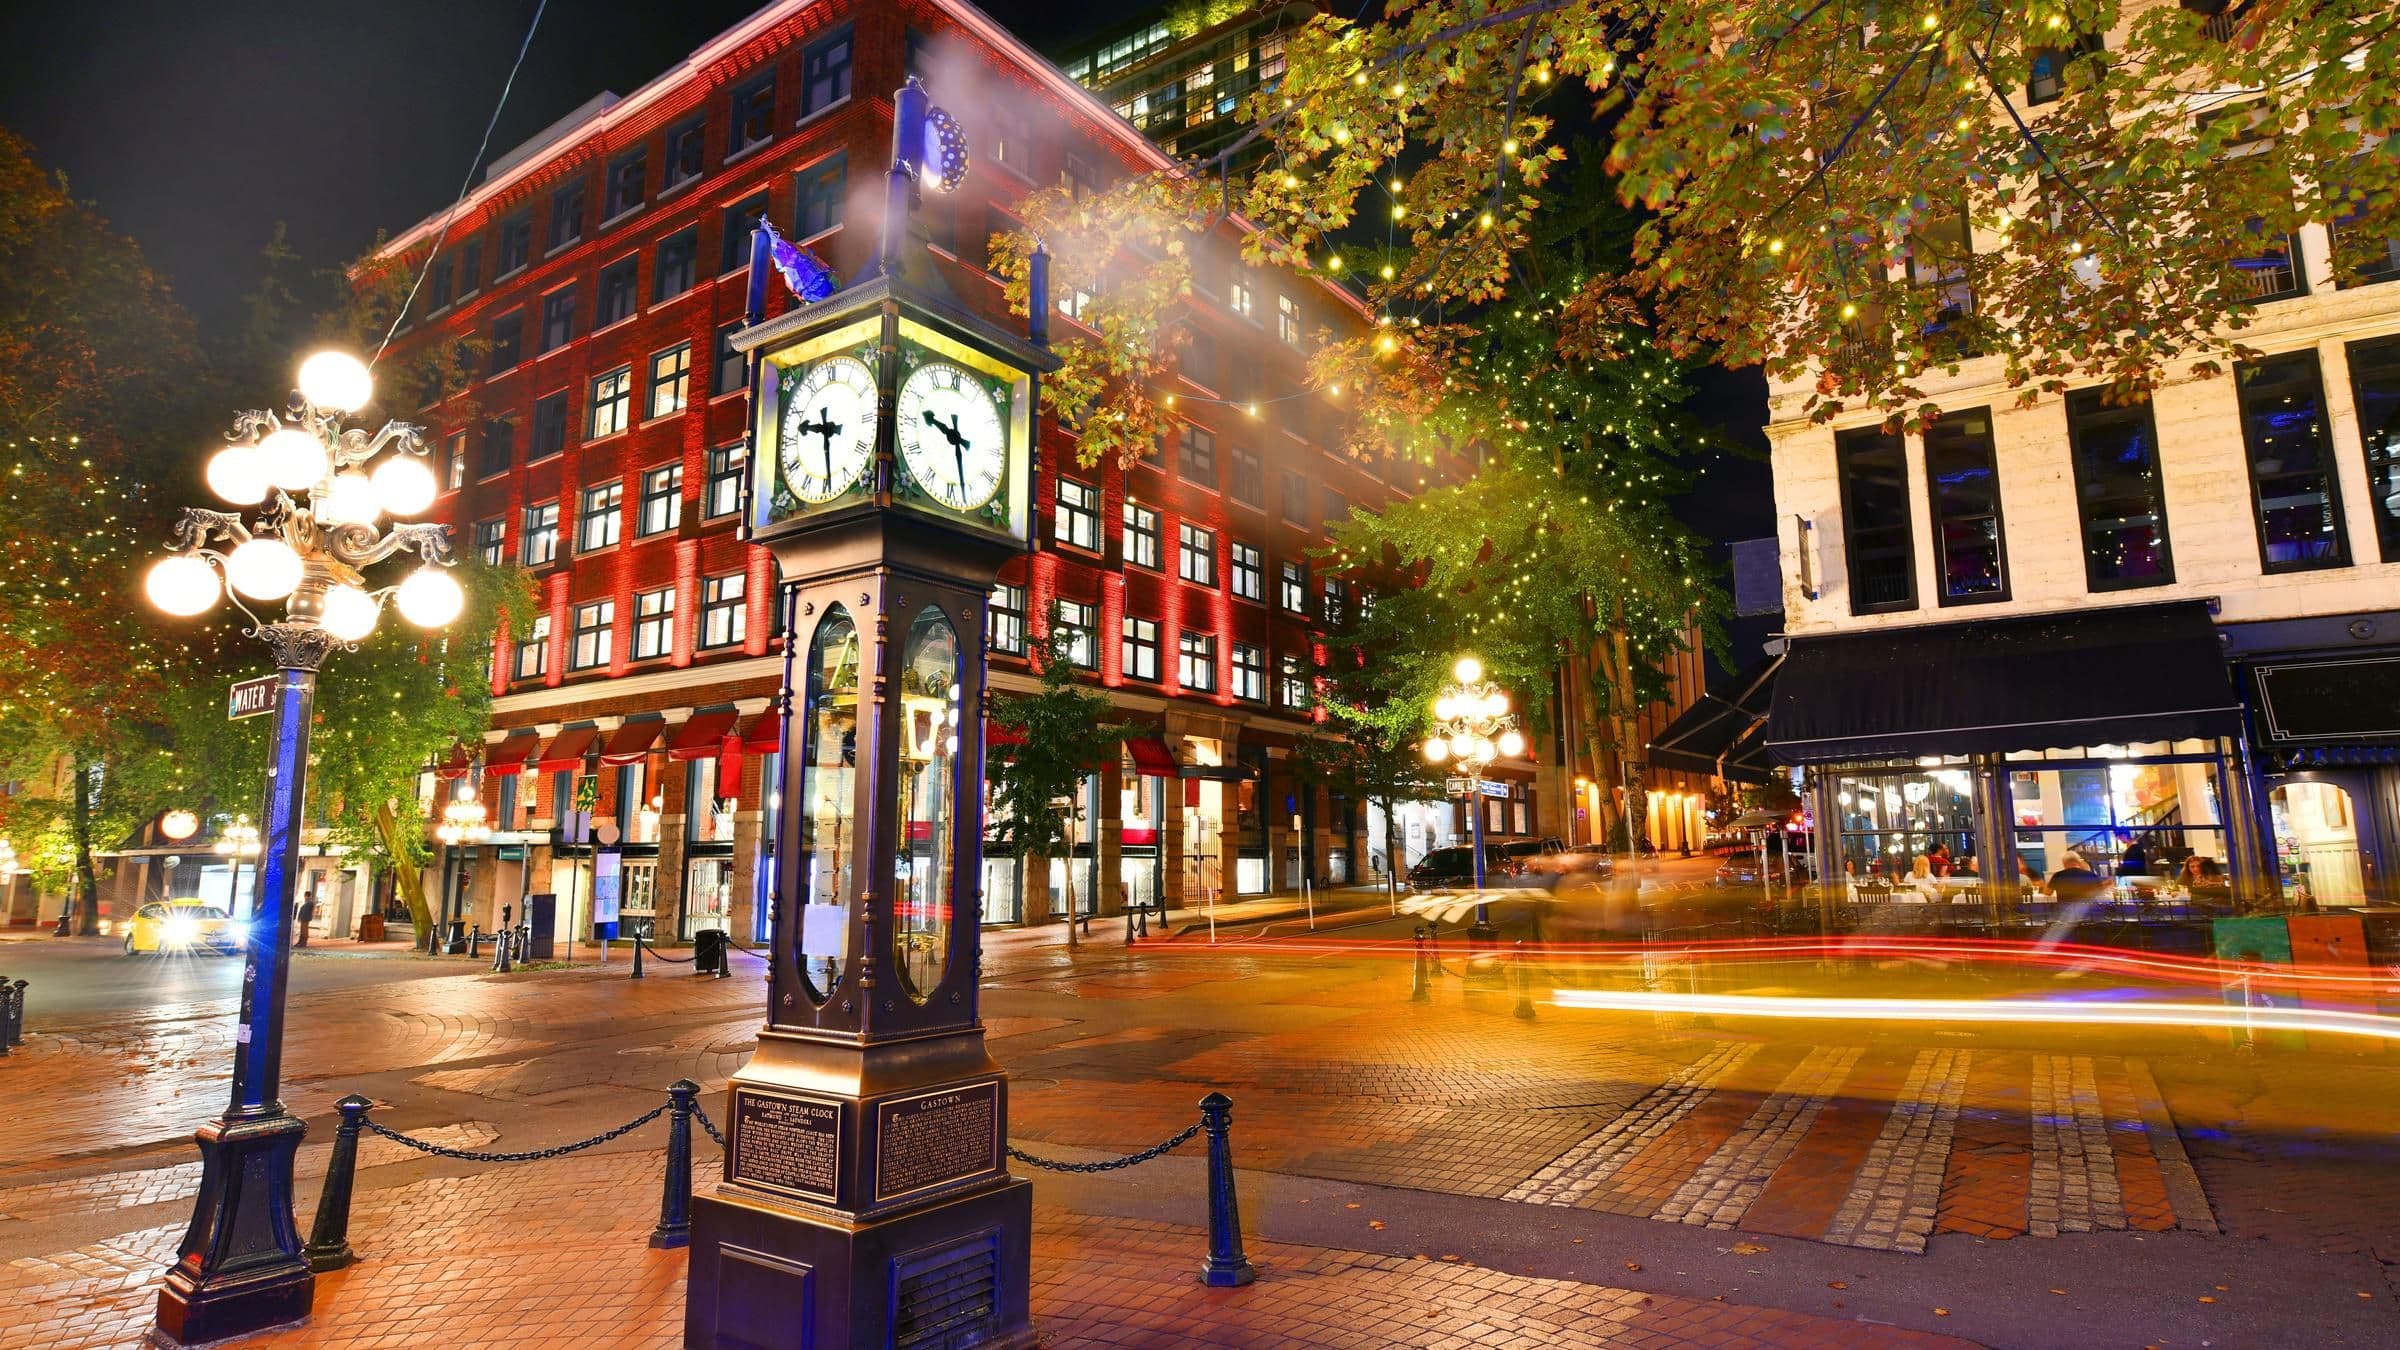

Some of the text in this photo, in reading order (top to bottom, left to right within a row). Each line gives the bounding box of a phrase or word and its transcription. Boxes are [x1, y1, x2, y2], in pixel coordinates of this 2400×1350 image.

[235, 685, 265, 712] WATER
[744, 1098, 756, 1106] THE
[757, 1100, 788, 1112] GASTOWN
[789, 1104, 810, 1116] STEAM
[810, 1108, 834, 1119] CLOCK
[920, 1095, 961, 1110] GASTOWN
